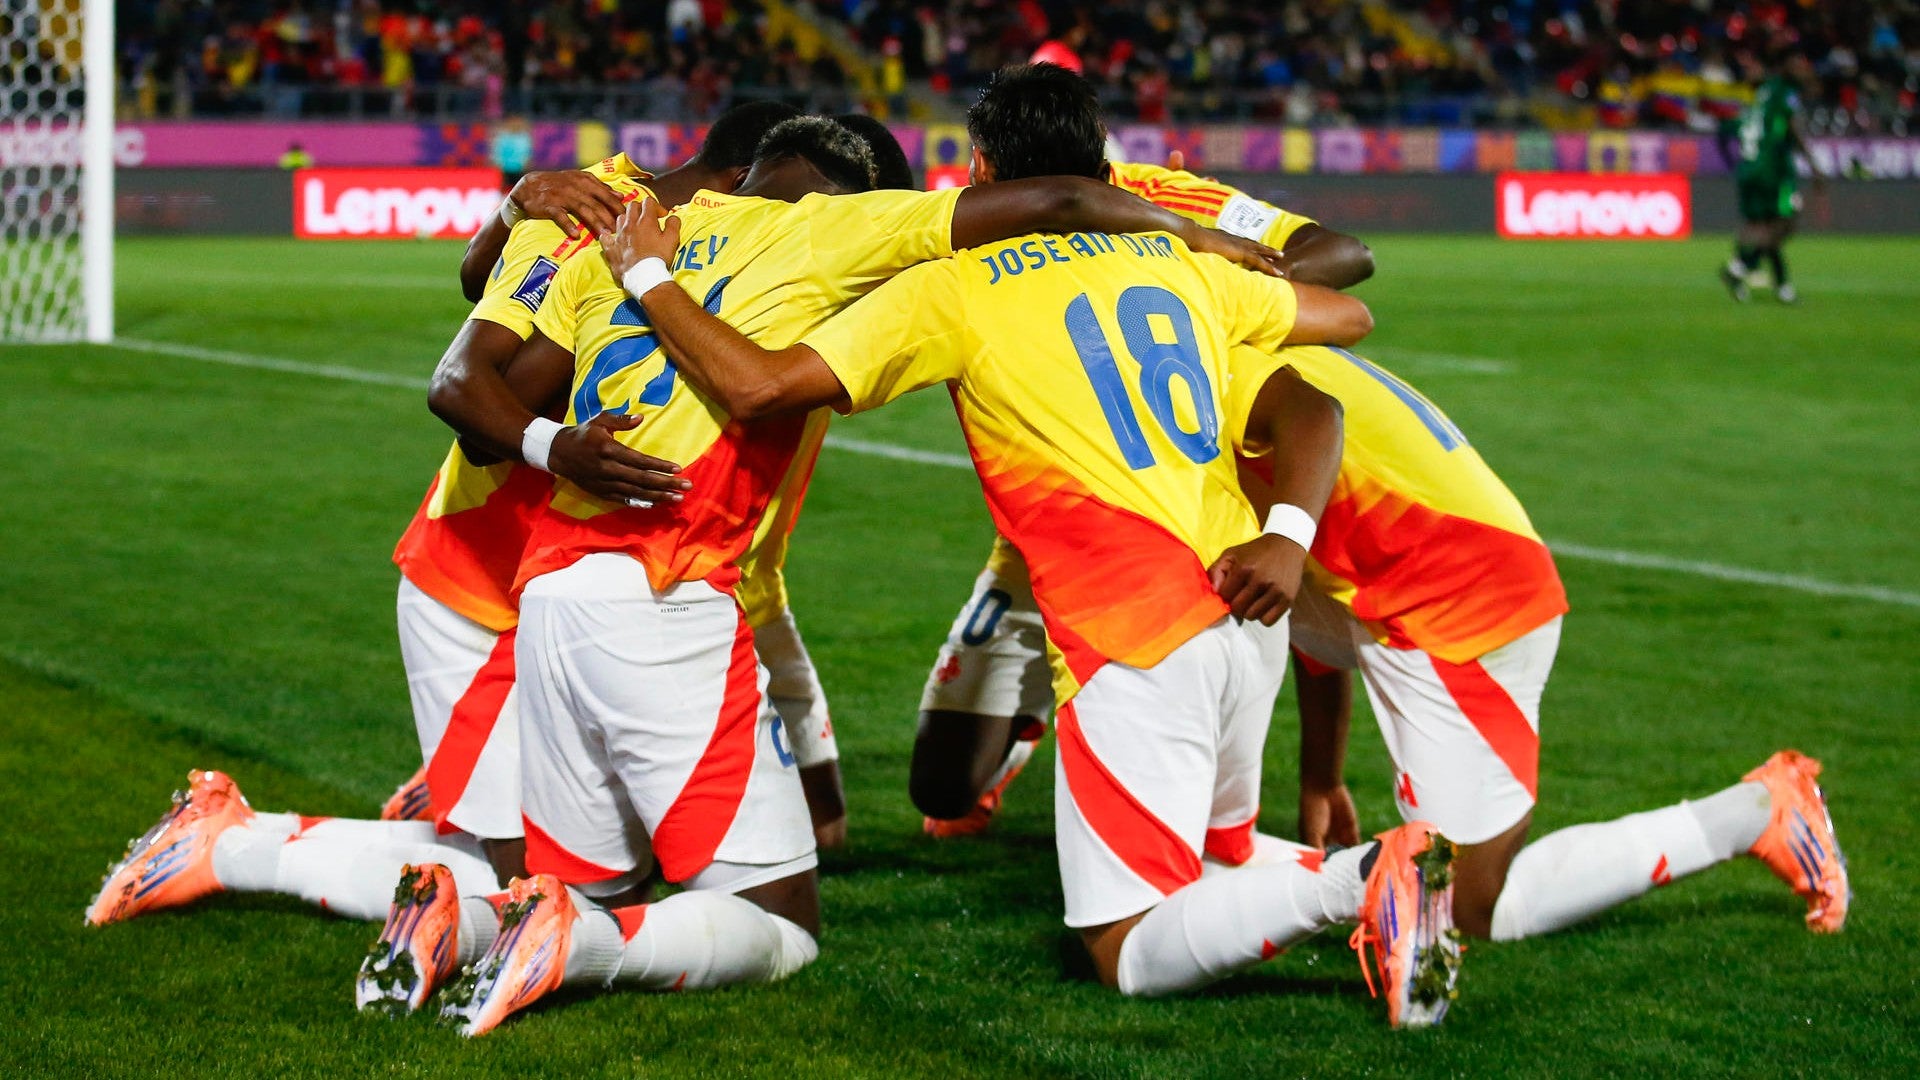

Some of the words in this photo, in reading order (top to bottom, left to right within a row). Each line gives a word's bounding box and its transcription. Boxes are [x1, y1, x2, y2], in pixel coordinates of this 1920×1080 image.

[304, 178, 500, 233] Lenov
[1504, 180, 1683, 235] Lenovo
[1065, 286, 1221, 470] 18
